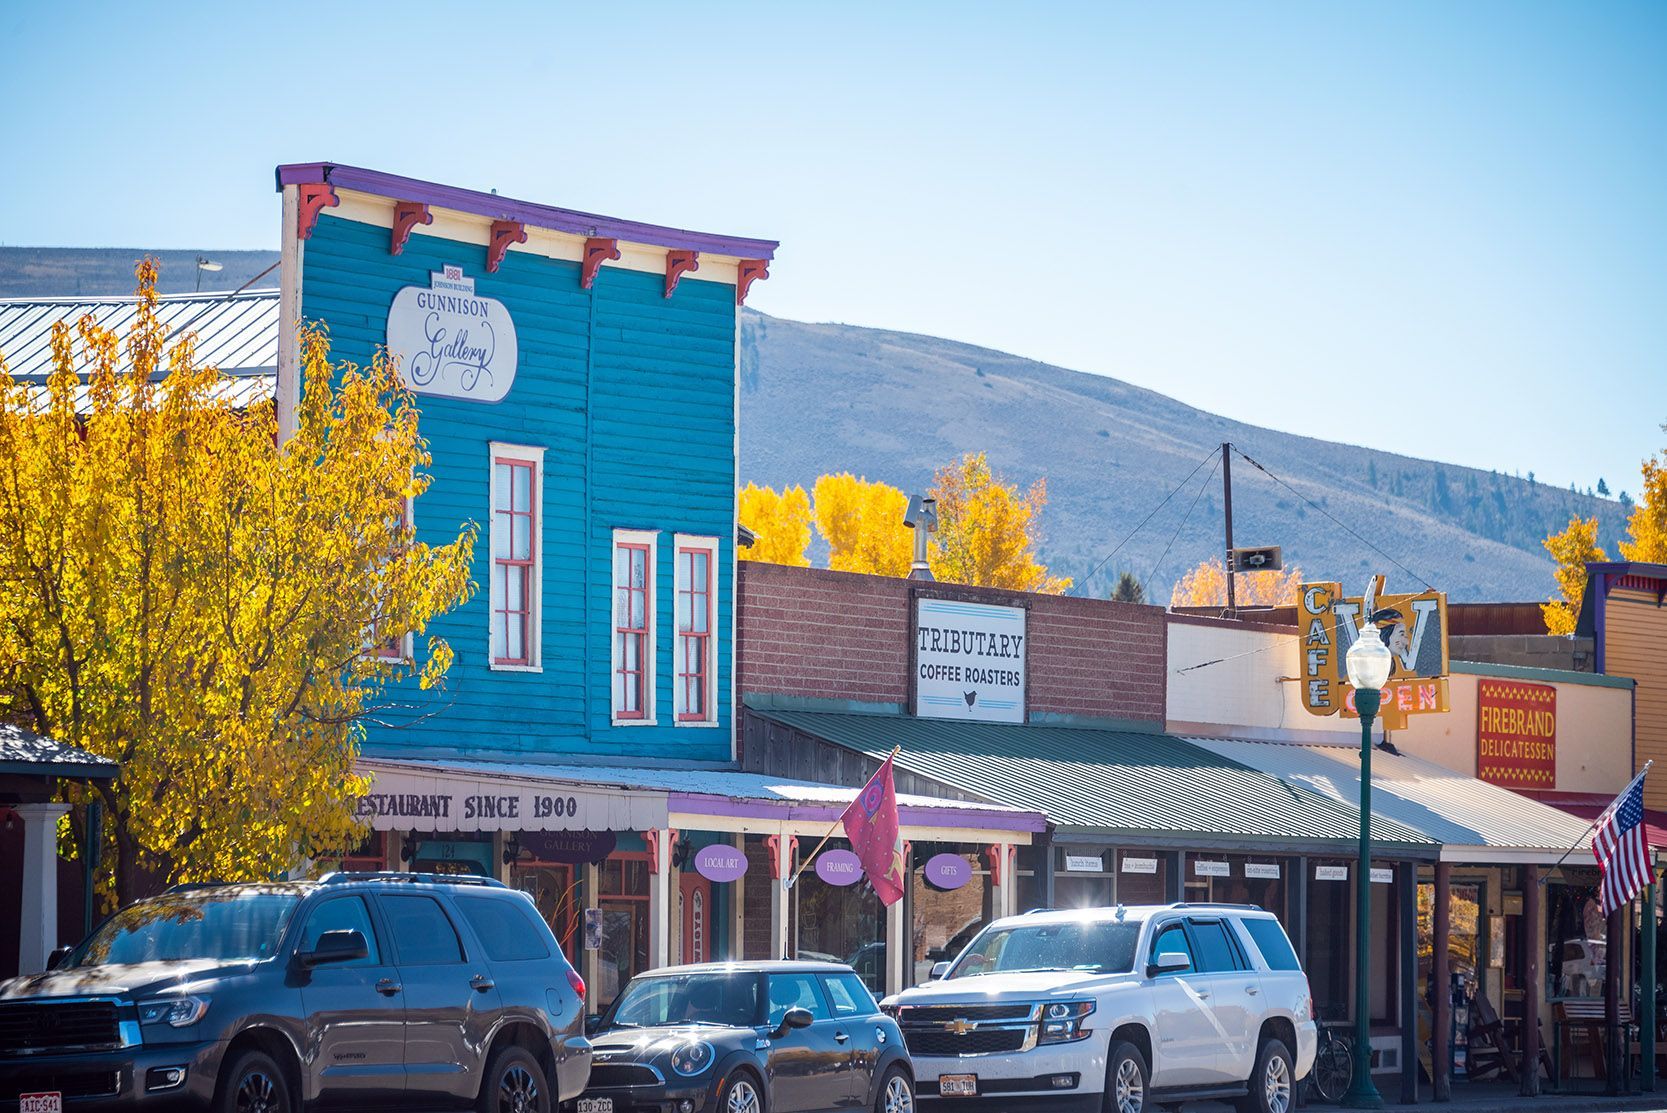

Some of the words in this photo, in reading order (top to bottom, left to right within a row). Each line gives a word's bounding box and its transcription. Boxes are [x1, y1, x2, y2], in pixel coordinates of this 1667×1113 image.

[417, 292, 489, 318] GUNNISON
[411, 311, 495, 391] Gallery
[918, 626, 1023, 659] TRIBUTARY
[1304, 587, 1330, 707] CAFE
[920, 663, 961, 682] COFFEE
[965, 667, 1020, 687] ROASTERS
[1481, 706, 1555, 738] FIREBRAND
[1481, 739, 1554, 760] DELICATESSEN
[351, 793, 453, 818] ESTAURANT
[464, 795, 520, 819] SINCE
[533, 796, 577, 818] 1900
[544, 840, 592, 852] GALLERY
[704, 857, 724, 869] LOCAL
[725, 857, 739, 869] ART
[826, 861, 854, 873] FRAMING
[940, 865, 957, 876] GIFTS
